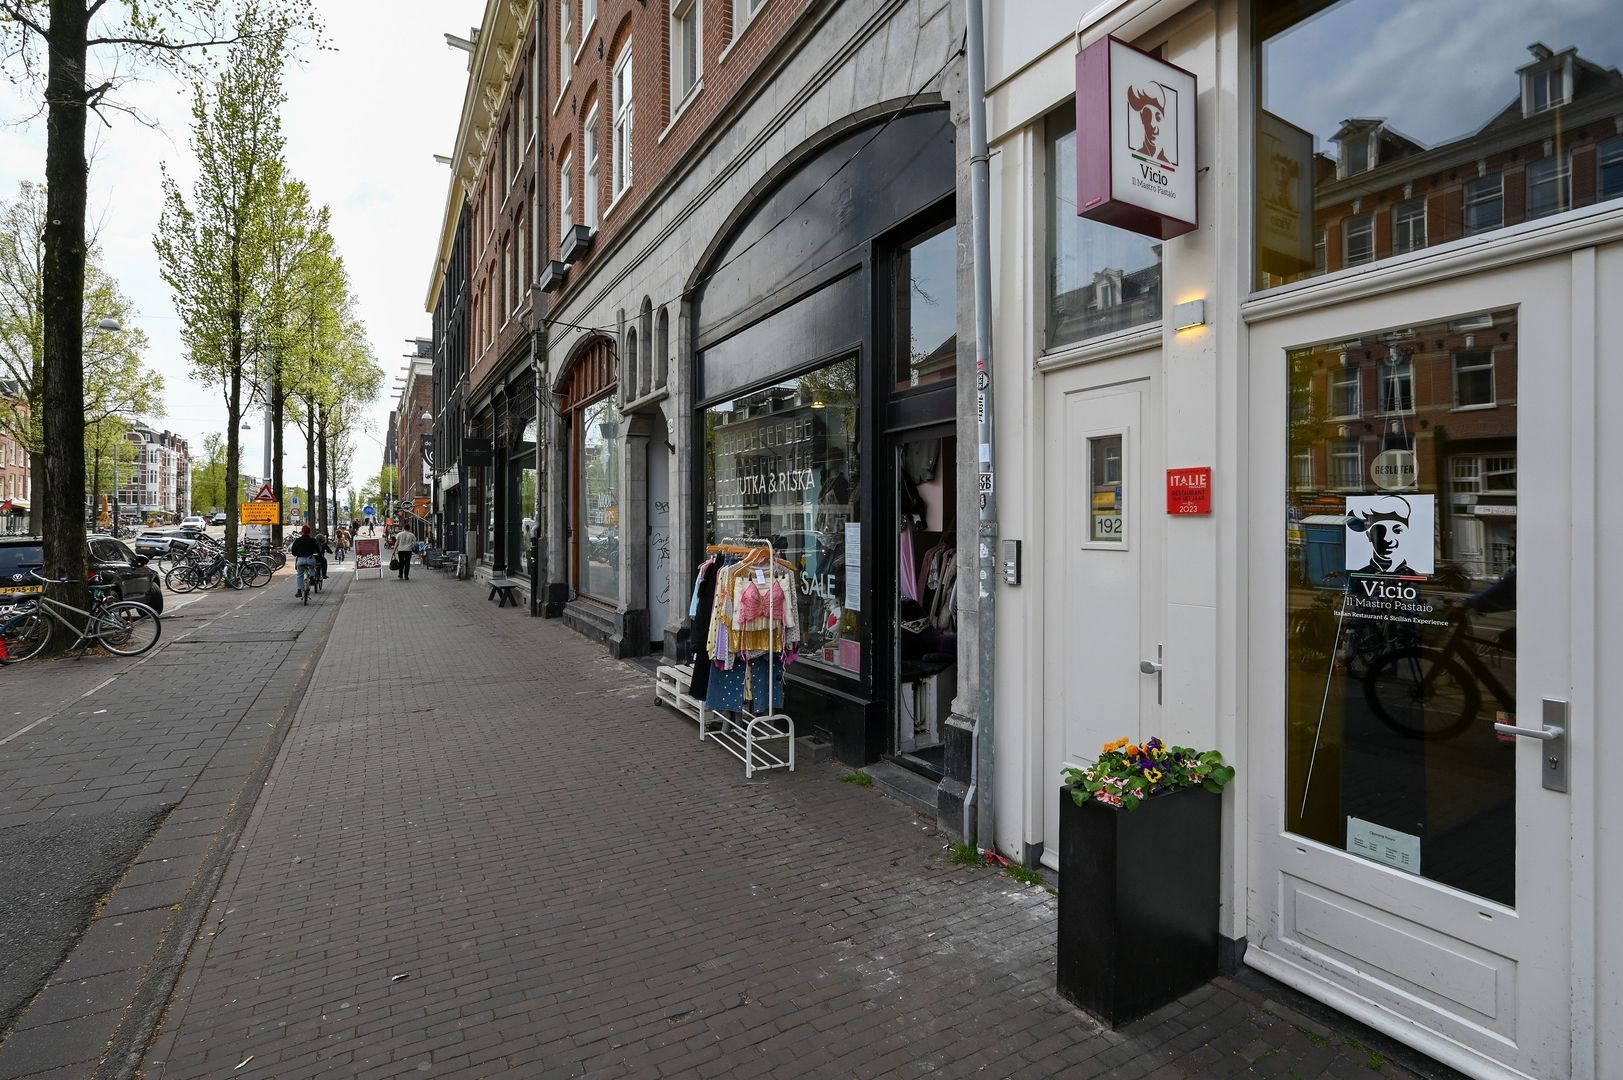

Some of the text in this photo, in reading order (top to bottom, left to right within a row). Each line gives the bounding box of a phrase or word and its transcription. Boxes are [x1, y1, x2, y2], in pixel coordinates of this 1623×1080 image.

[1140, 164, 1168, 186] Vicio
[1132, 176, 1176, 198] Il Mastro Pastaio
[736, 474, 767, 495] JUTKA
[778, 468, 815, 492] RISKA
[1170, 474, 1207, 487] ITALIE
[1179, 505, 1198, 513] 2023
[1097, 518, 1122, 534] 192
[801, 571, 836, 600] SALE
[1360, 580, 1417, 600] Vicio
[1345, 597, 1433, 613] Il Mastro Pastaio
[1352, 611, 1384, 620] Restaurant
[1389, 615, 1412, 623] Sicilian
[1413, 617, 1449, 627] Experience
